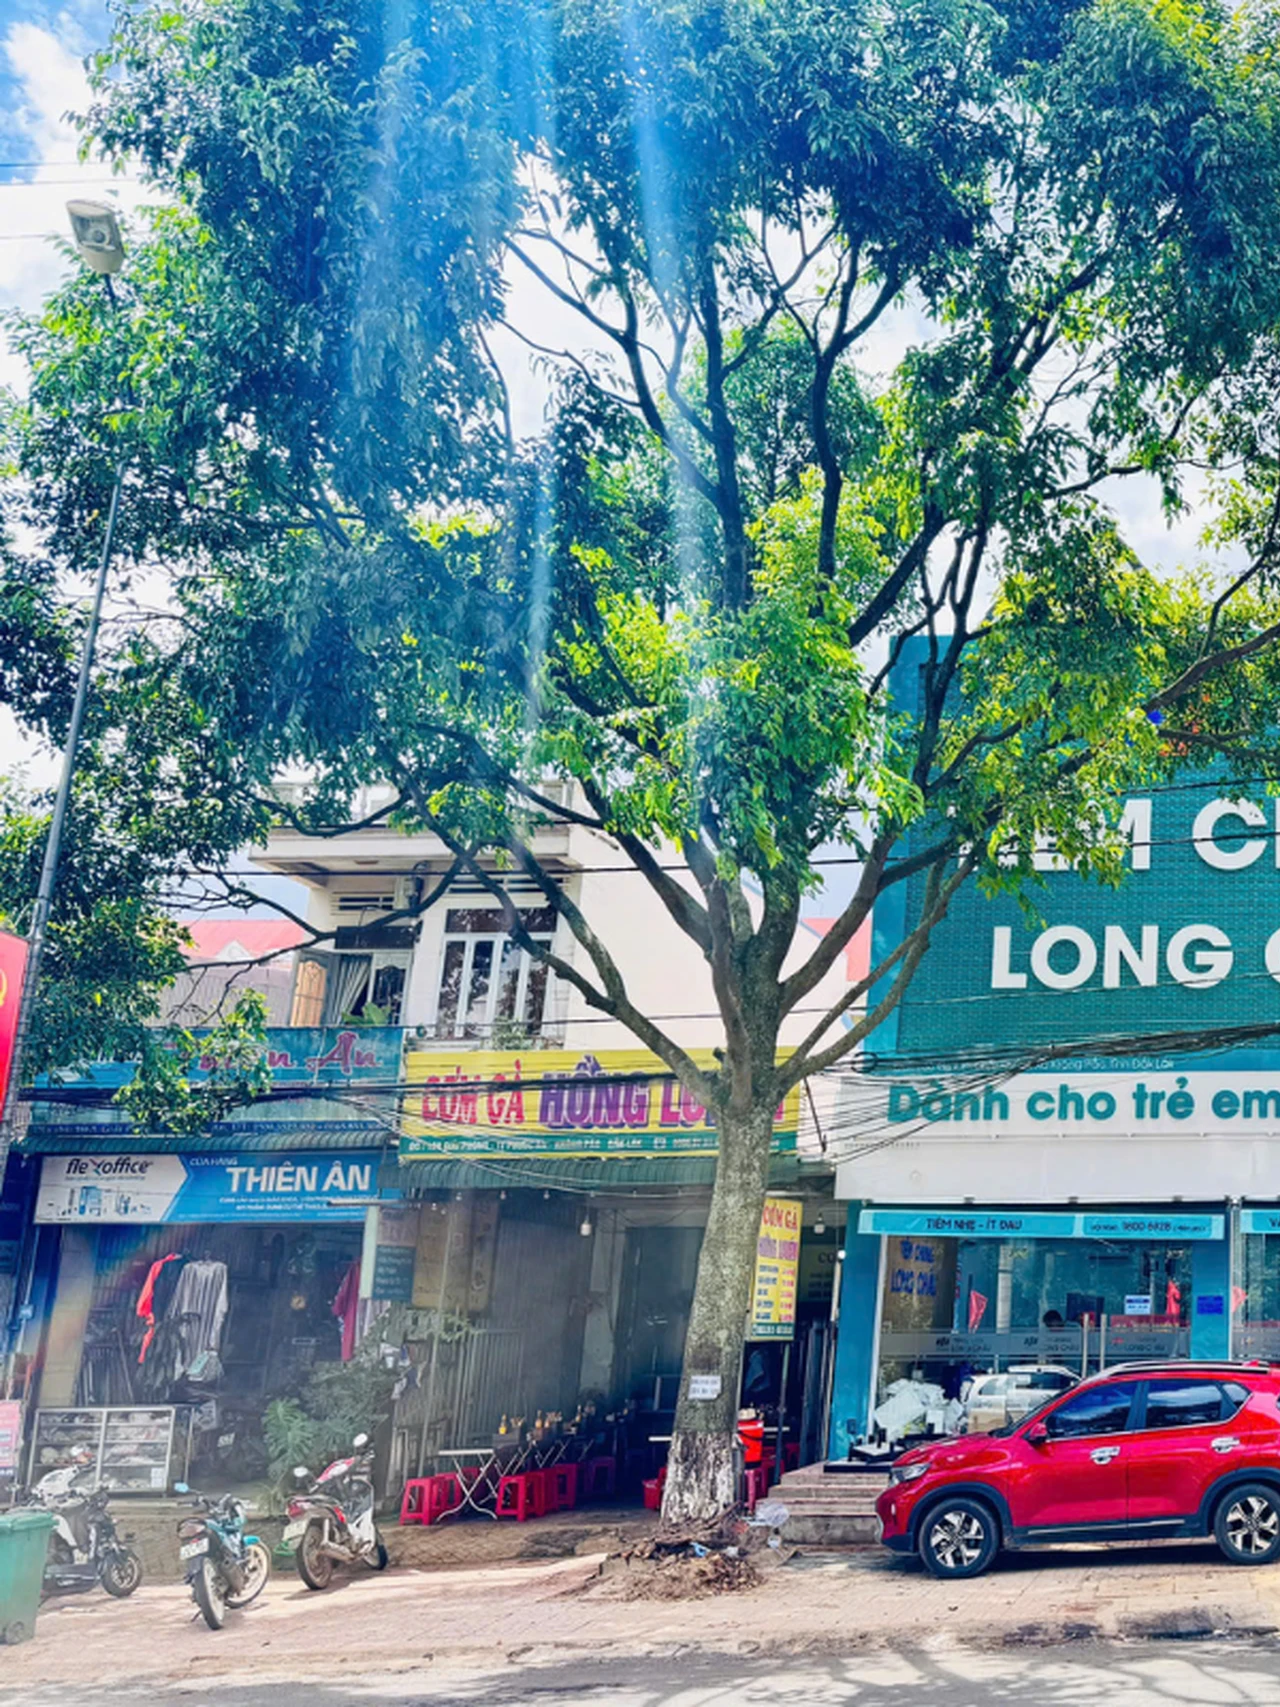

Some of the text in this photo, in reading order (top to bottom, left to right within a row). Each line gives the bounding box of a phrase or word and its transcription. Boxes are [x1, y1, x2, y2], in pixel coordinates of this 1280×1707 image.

[990, 924, 1234, 989] LONG
[539, 1053, 650, 1129] HỒNG
[887, 1079, 1010, 1121] Dành
[1026, 1083, 1117, 1121] cho
[1132, 1076, 1195, 1120] trẻ
[226, 1160, 372, 1193] THIÊN ÂN
[926, 1217, 951, 1230] TIÊM
[954, 1218, 976, 1231] NHẸ
